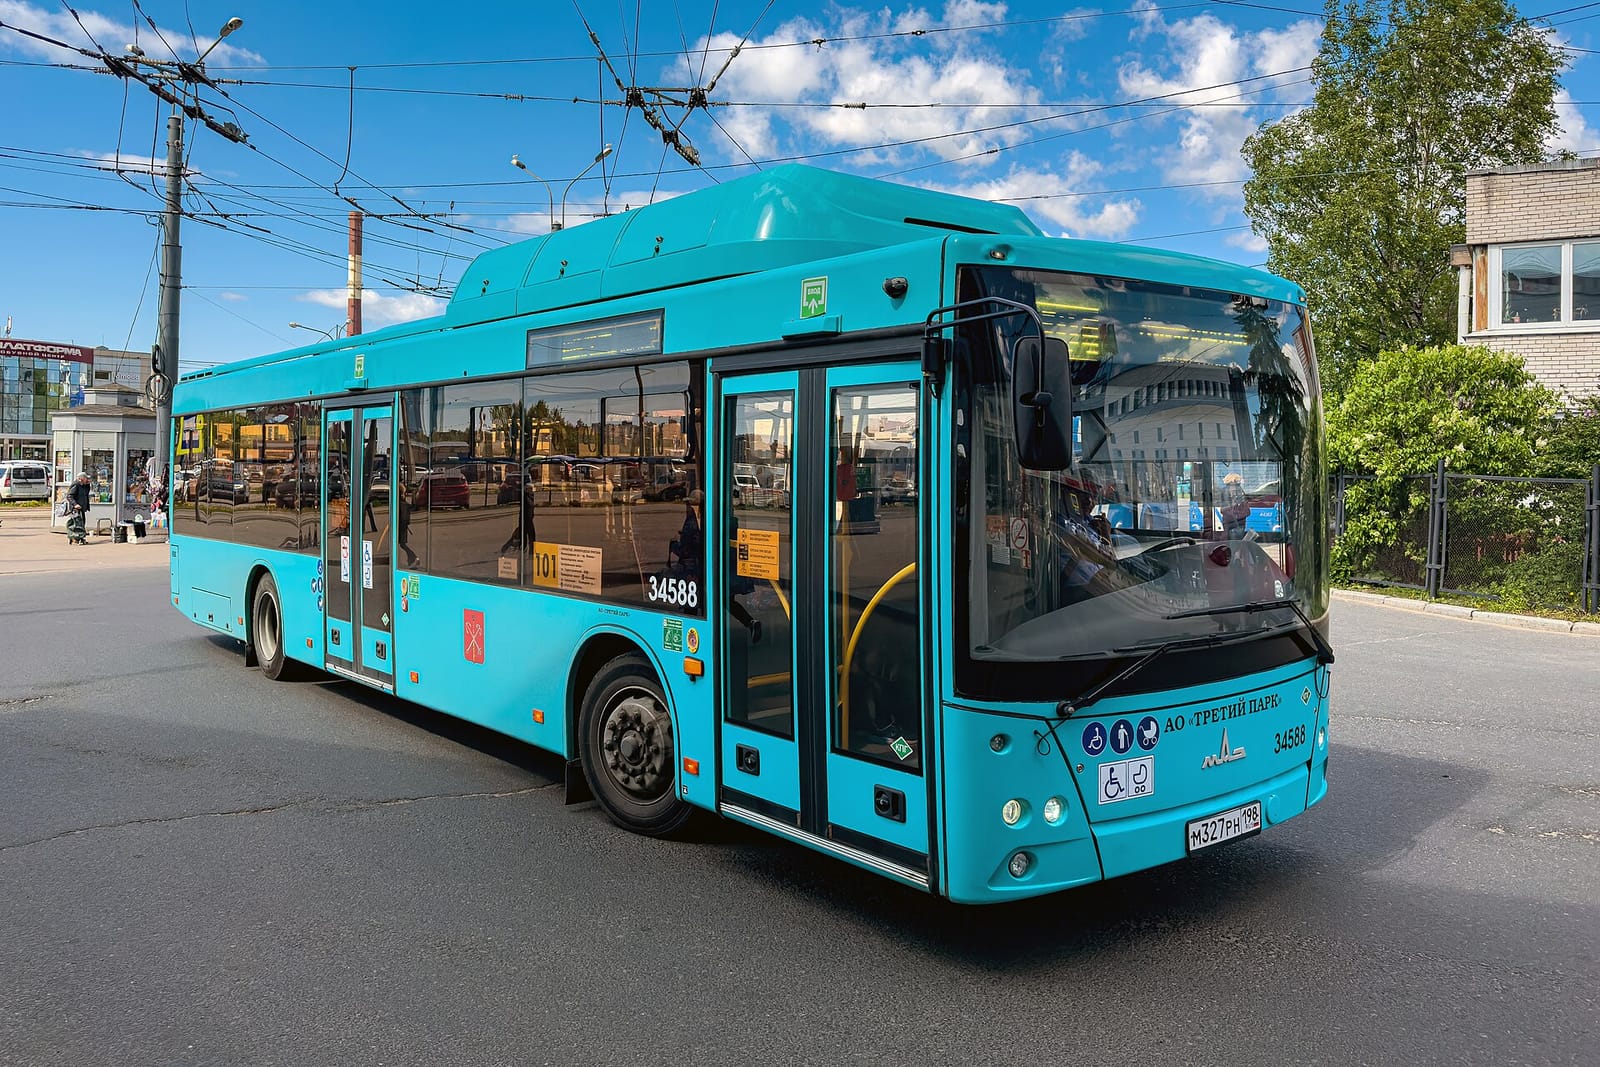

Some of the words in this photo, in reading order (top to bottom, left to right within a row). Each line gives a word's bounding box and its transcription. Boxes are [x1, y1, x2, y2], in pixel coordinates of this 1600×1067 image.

[535, 552, 556, 579] 101
[648, 575, 698, 608] 34588
[1164, 715, 1185, 733] АО
[1188, 697, 1246, 727] «ТРЕТИЙ
[1274, 723, 1306, 754] 34588
[1190, 817, 1241, 847] М327РН
[1242, 806, 1259, 824] 198
